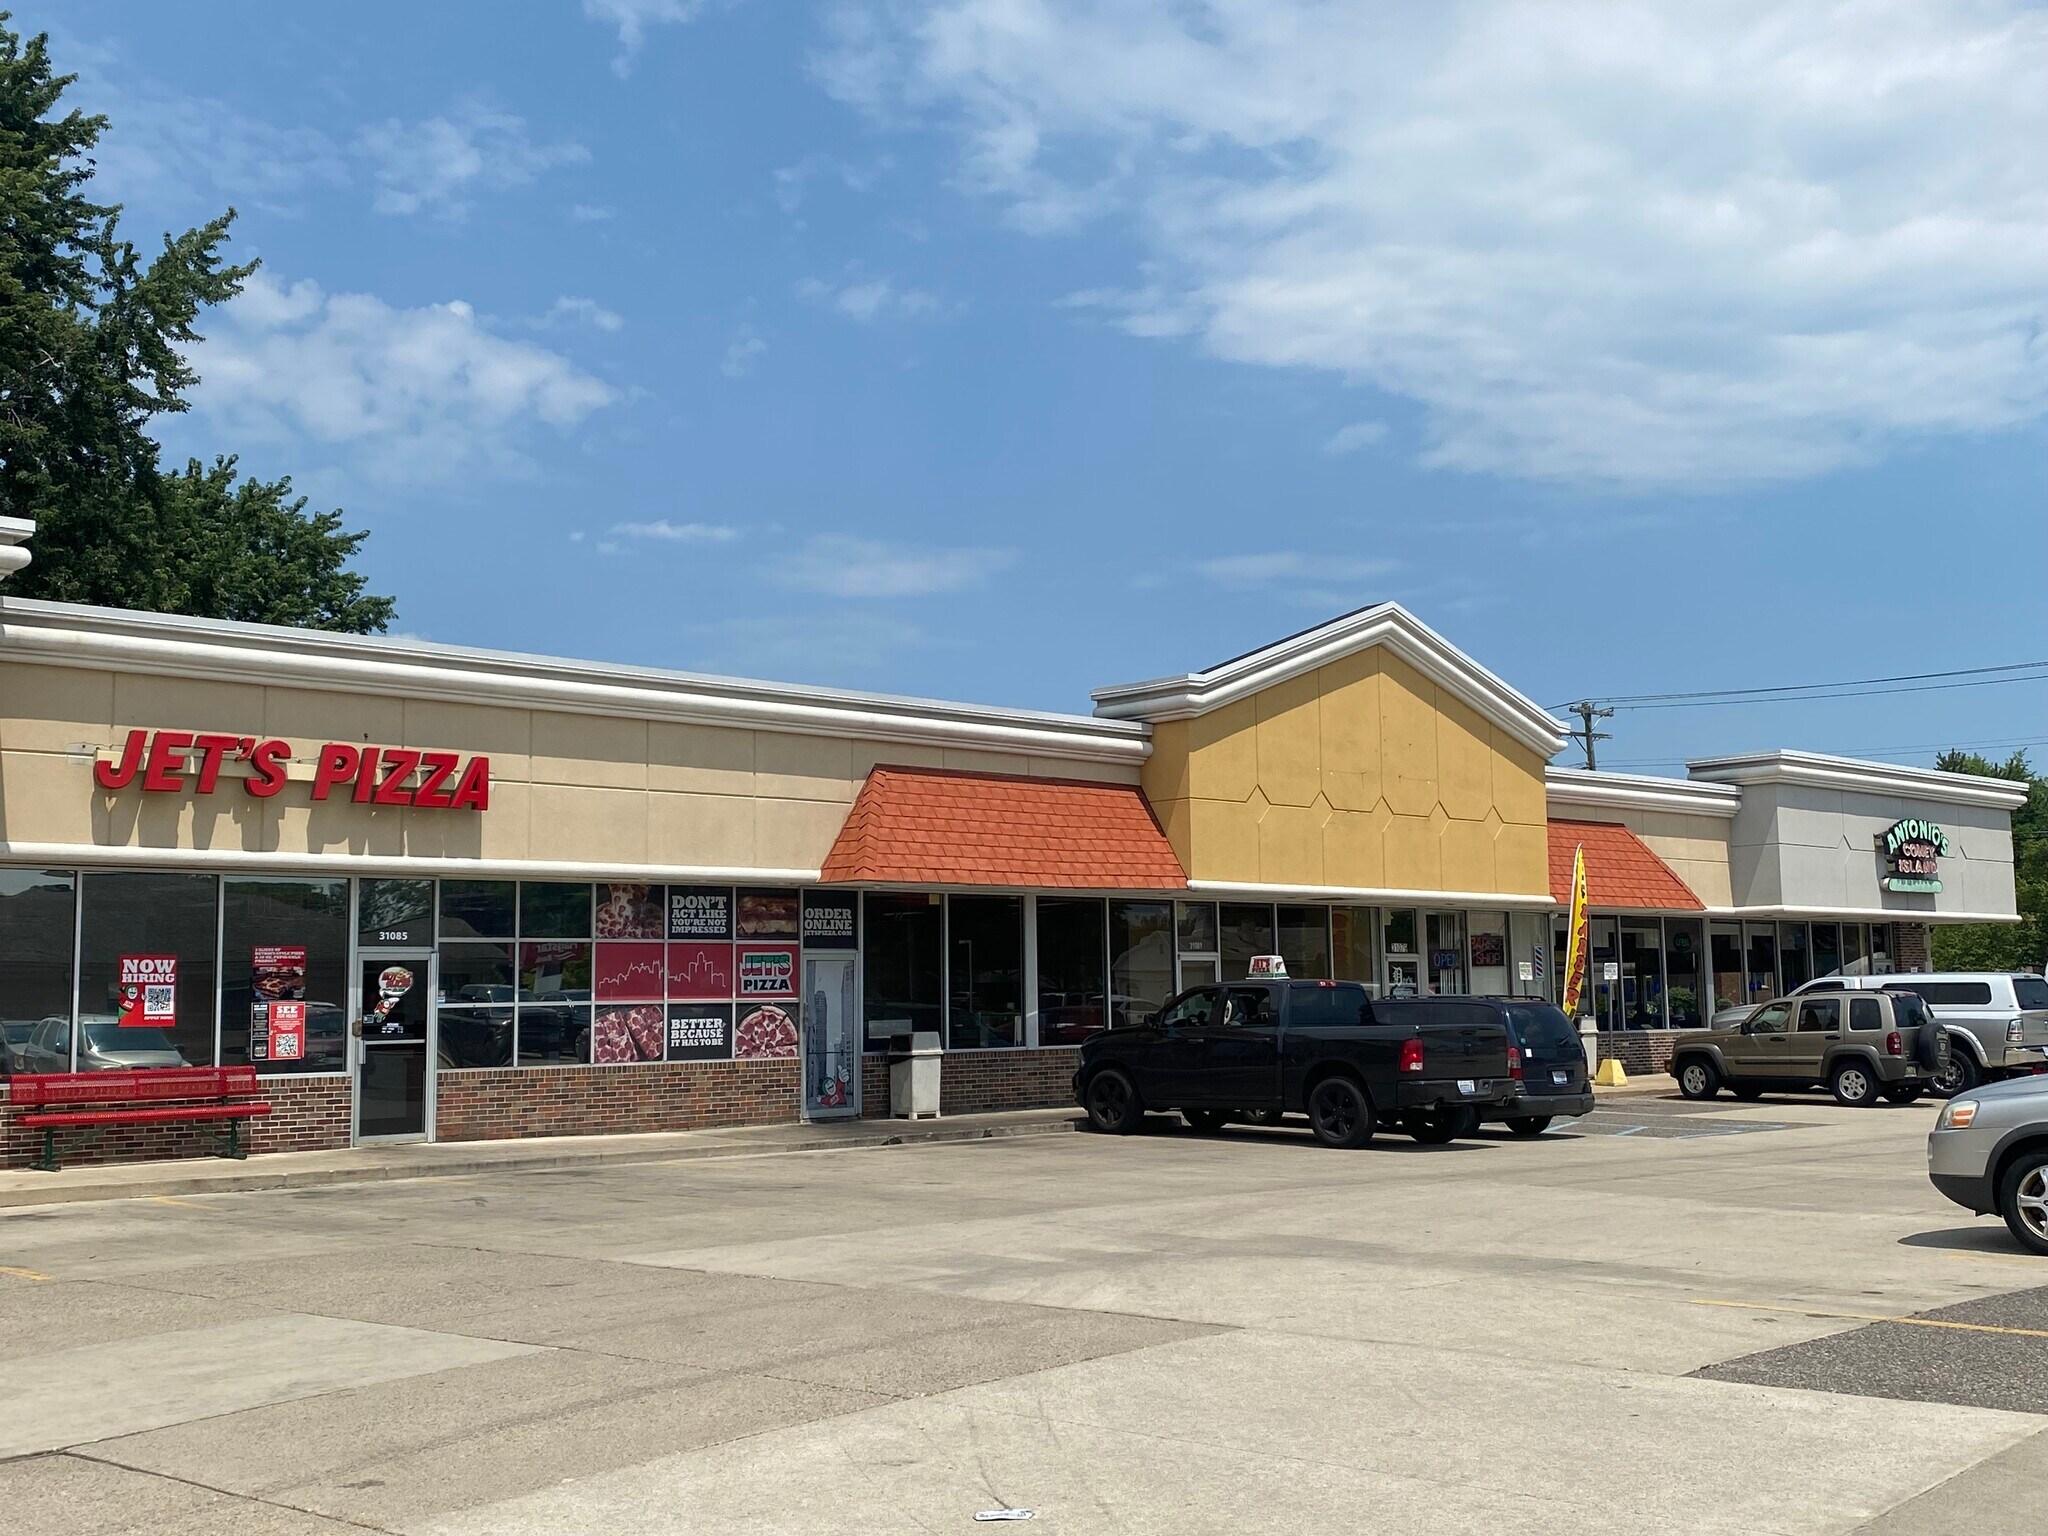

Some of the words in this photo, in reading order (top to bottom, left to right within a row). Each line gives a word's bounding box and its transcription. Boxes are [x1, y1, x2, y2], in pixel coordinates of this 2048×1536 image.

[93, 729, 290, 797] JET'S
[310, 744, 488, 811] PIZZA
[1886, 818, 1949, 857] ANTONIO'S
[1902, 842, 1937, 859] CONEY
[1898, 858, 1938, 874] ISLAND
[671, 895, 727, 909] DON'T
[671, 909, 697, 919] ACT
[698, 909, 727, 919] LIKE
[804, 907, 852, 919] ORDER
[804, 919, 852, 930] ONLINE
[378, 931, 408, 941] 31085
[1475, 952, 1501, 965] SHOP
[122, 959, 176, 974] NOW
[741, 953, 791, 977] JET'S
[121, 973, 175, 983] HIRING
[743, 978, 790, 991] PIZZA
[276, 1004, 299, 1015] SEE
[670, 1017, 723, 1029] BETTER
[670, 1028, 724, 1039] BECAUSE
[670, 1039, 681, 1047] IT
[681, 1039, 700, 1047] HAS
[711, 1038, 724, 1046] BE
